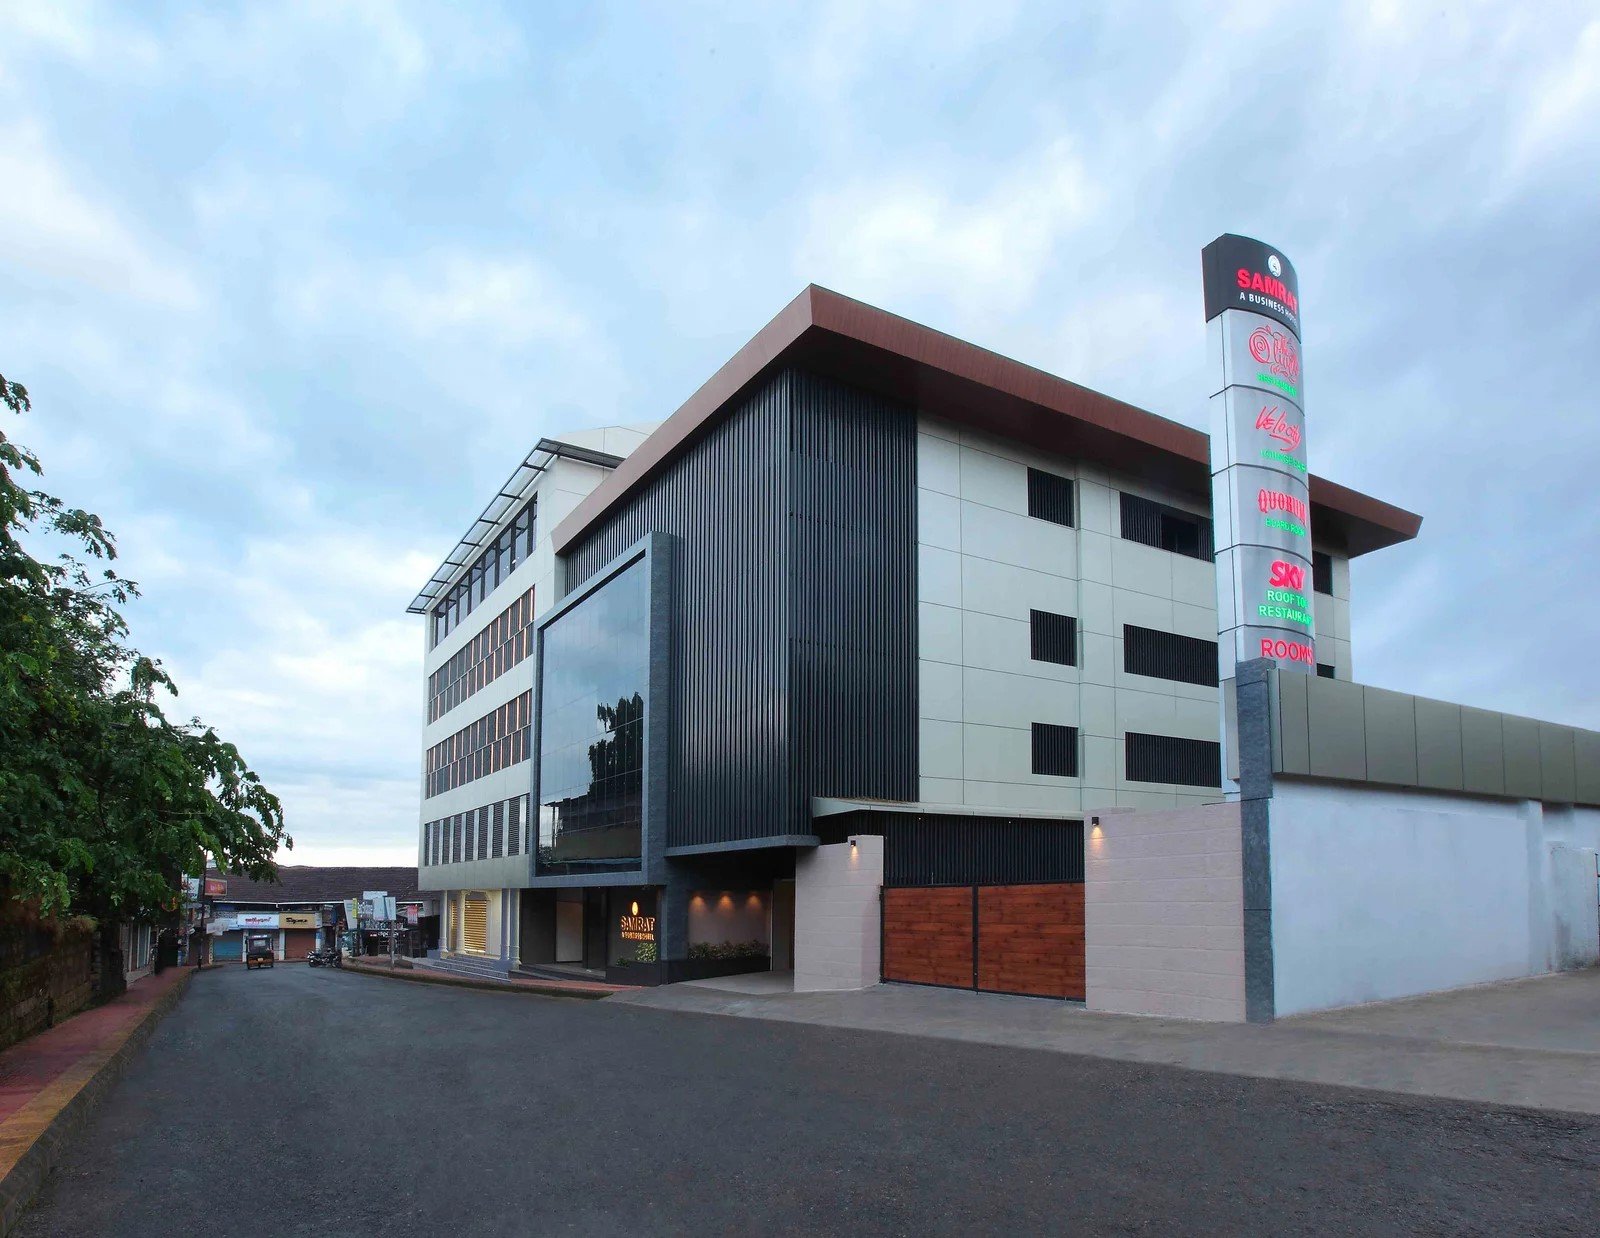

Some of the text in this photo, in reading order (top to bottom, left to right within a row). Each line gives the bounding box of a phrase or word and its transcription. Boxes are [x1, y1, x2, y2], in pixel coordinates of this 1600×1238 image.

[1237, 269, 1297, 315] SAMRAT
[1239, 292, 1285, 315] A BUSINESS
[1269, 560, 1305, 591] SKY
[1267, 589, 1294, 604] ROOF
[1261, 638, 1313, 666] ROOMS
[621, 915, 656, 931] SAMRAT
